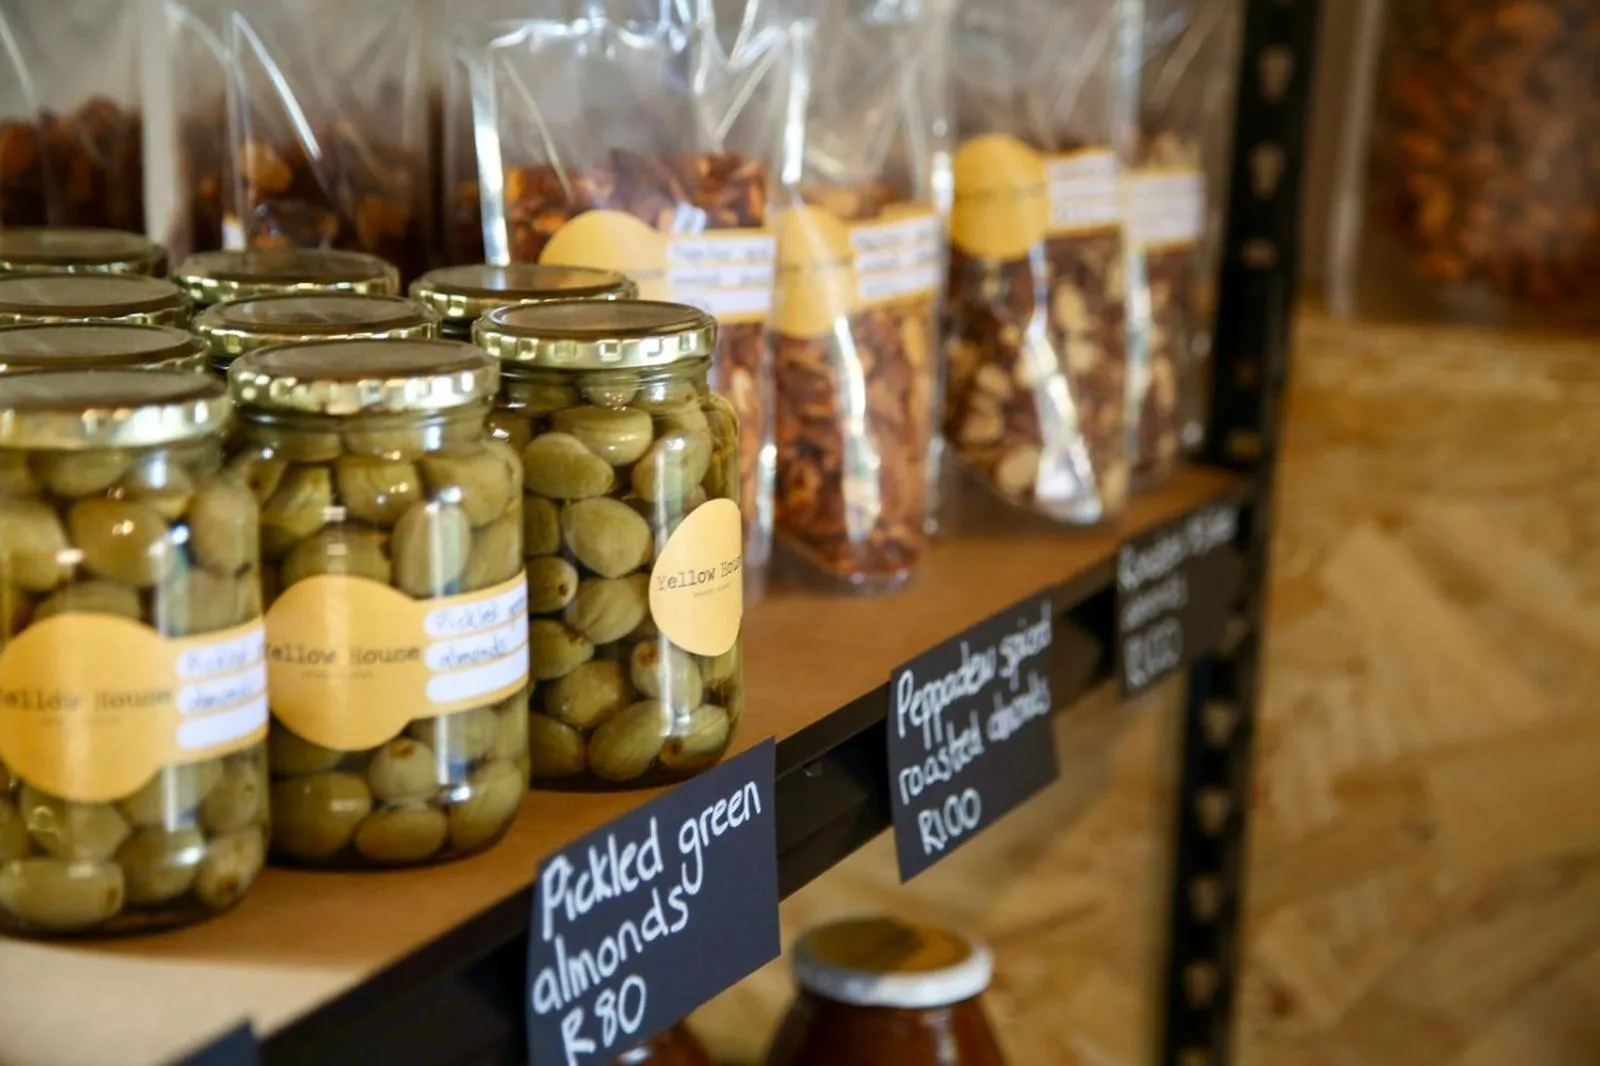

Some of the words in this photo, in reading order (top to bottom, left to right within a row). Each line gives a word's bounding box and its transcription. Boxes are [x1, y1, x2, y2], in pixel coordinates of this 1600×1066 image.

[656, 567, 717, 591] Yellow
[542, 816, 663, 941] Pickled
[678, 780, 762, 896] green
[531, 886, 690, 1015] almonds
